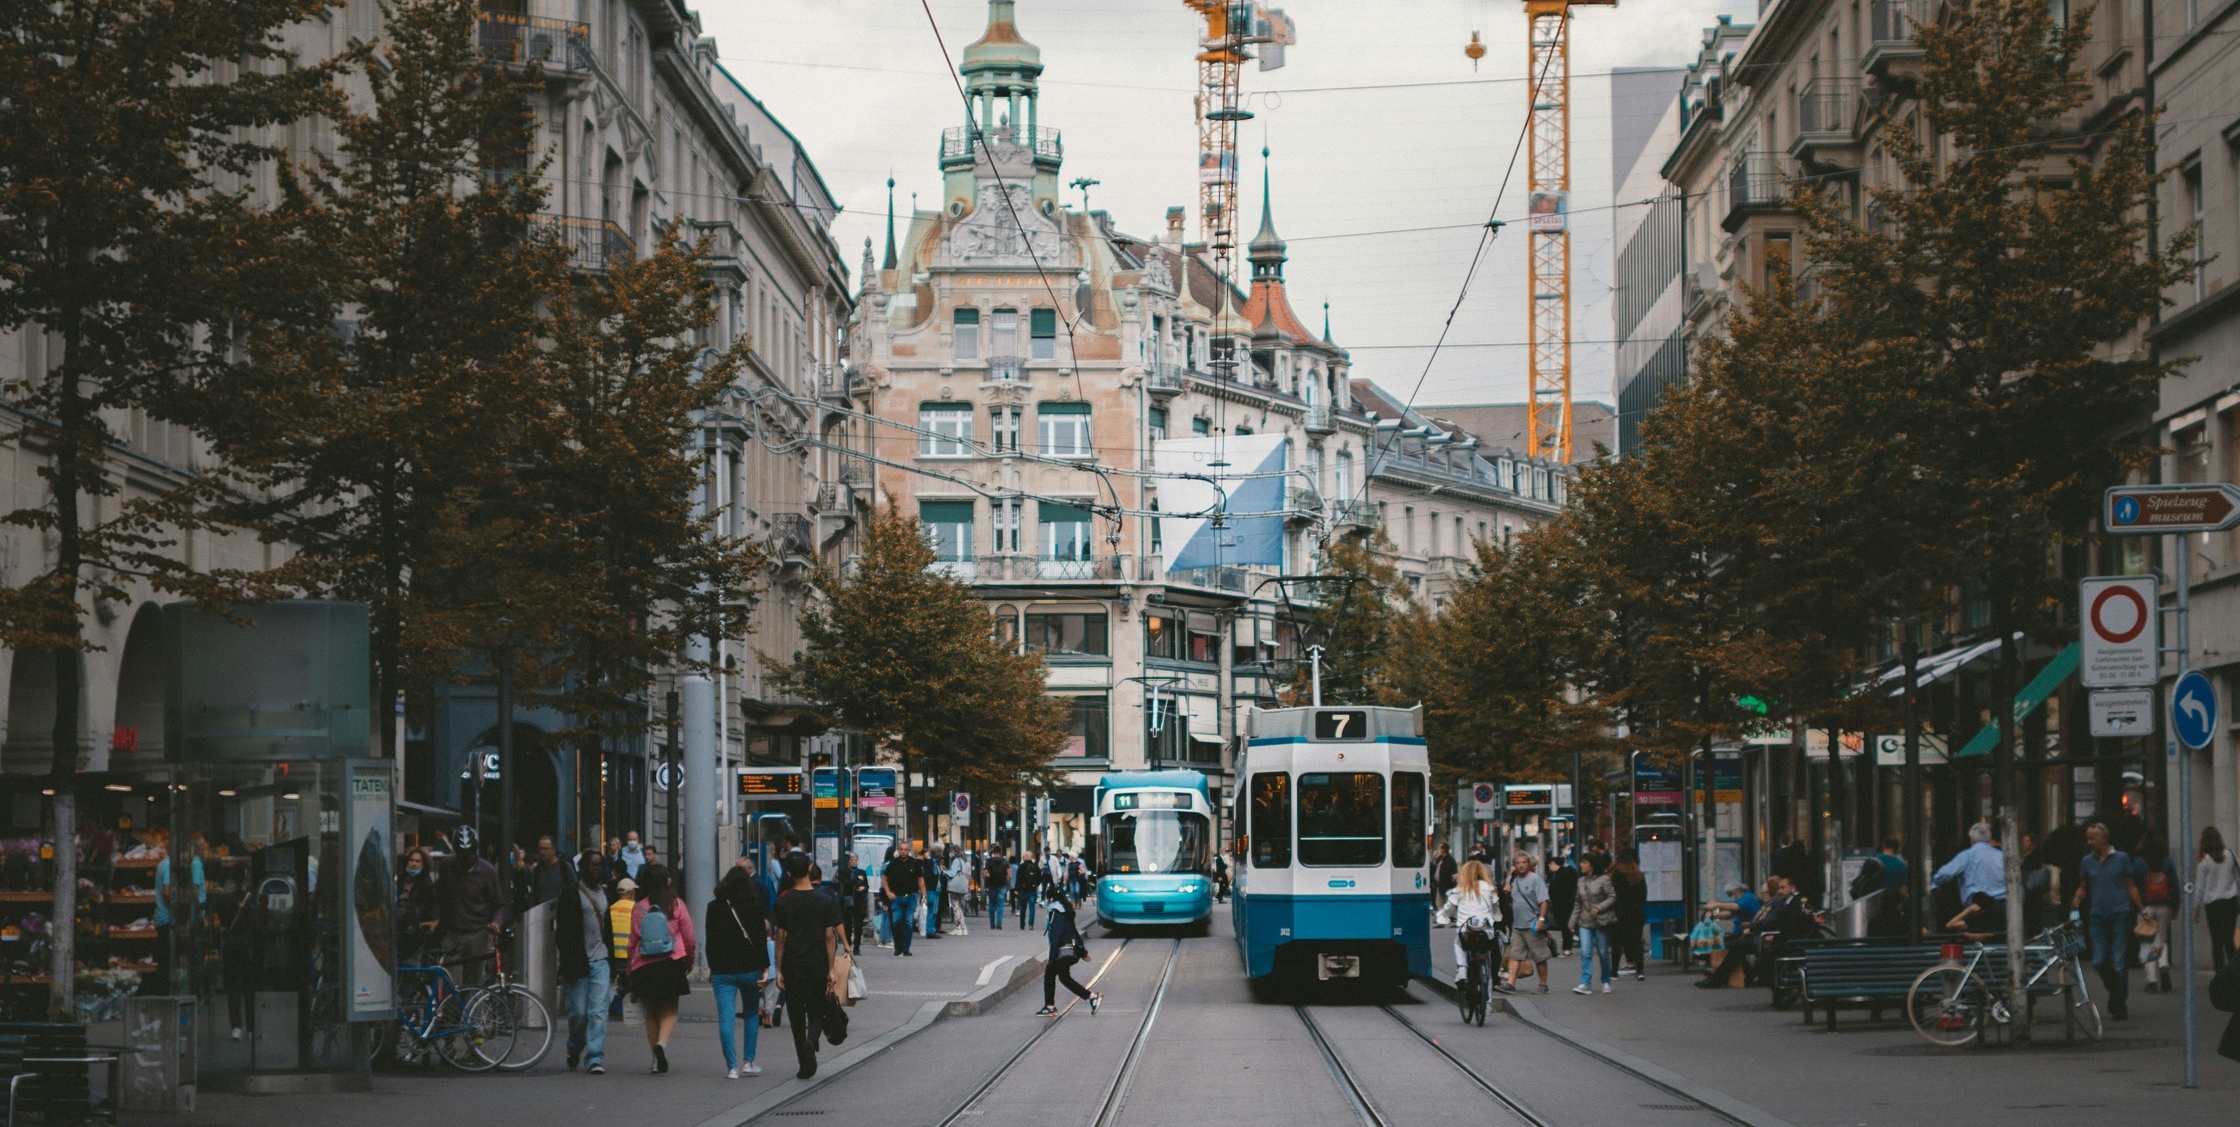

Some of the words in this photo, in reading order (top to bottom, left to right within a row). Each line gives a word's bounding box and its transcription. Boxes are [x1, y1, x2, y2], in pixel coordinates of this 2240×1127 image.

[2147, 495, 2210, 510] Spielzeug-
[2149, 512, 2204, 522] museum
[1332, 714, 1350, 738] 7
[1119, 795, 1131, 806] 11
[1639, 796, 1648, 804] 10
